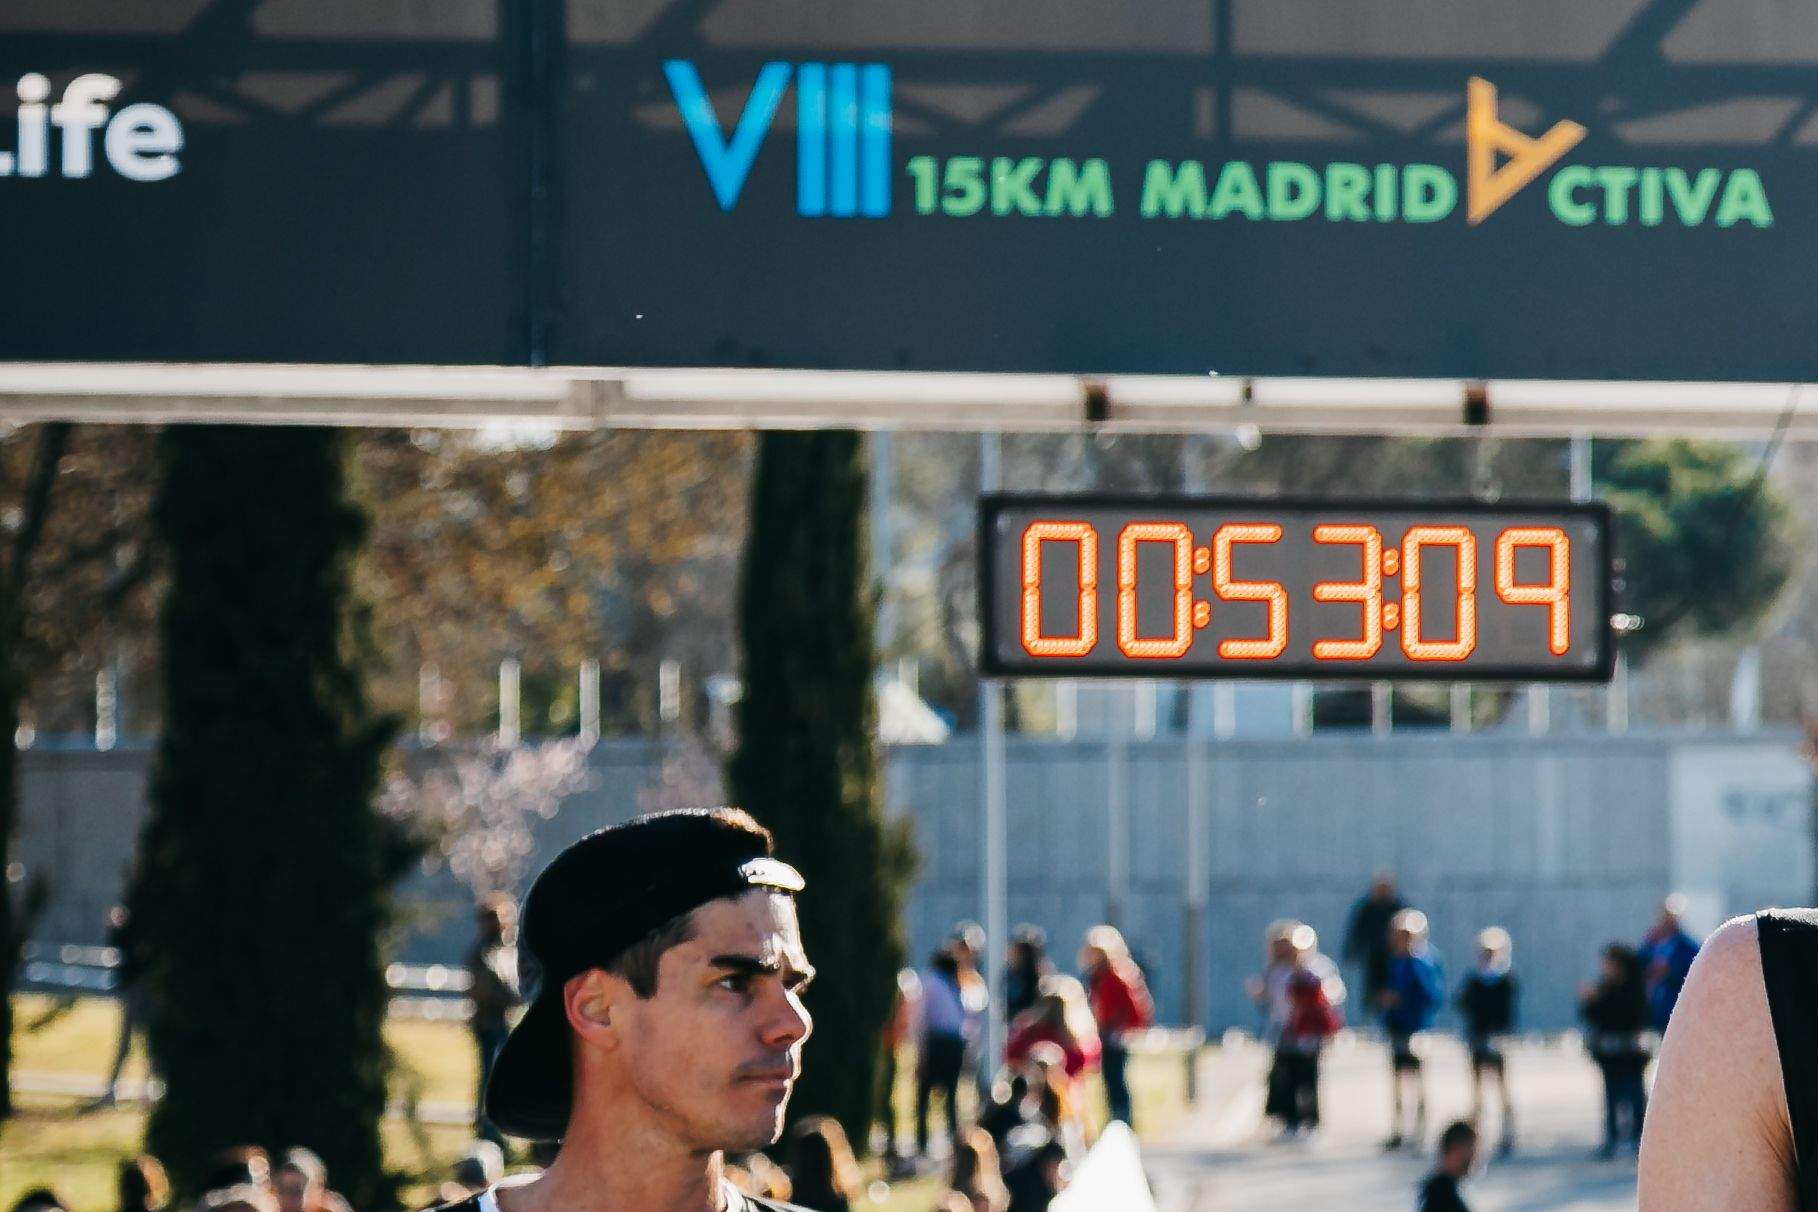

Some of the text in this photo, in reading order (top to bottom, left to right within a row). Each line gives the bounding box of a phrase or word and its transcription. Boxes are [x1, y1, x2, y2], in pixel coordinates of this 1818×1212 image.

[0, 72, 184, 181] ife
[662, 59, 891, 217] VIII
[906, 156, 1114, 218] 15KM
[1021, 520, 1570, 660] 00:53:09
